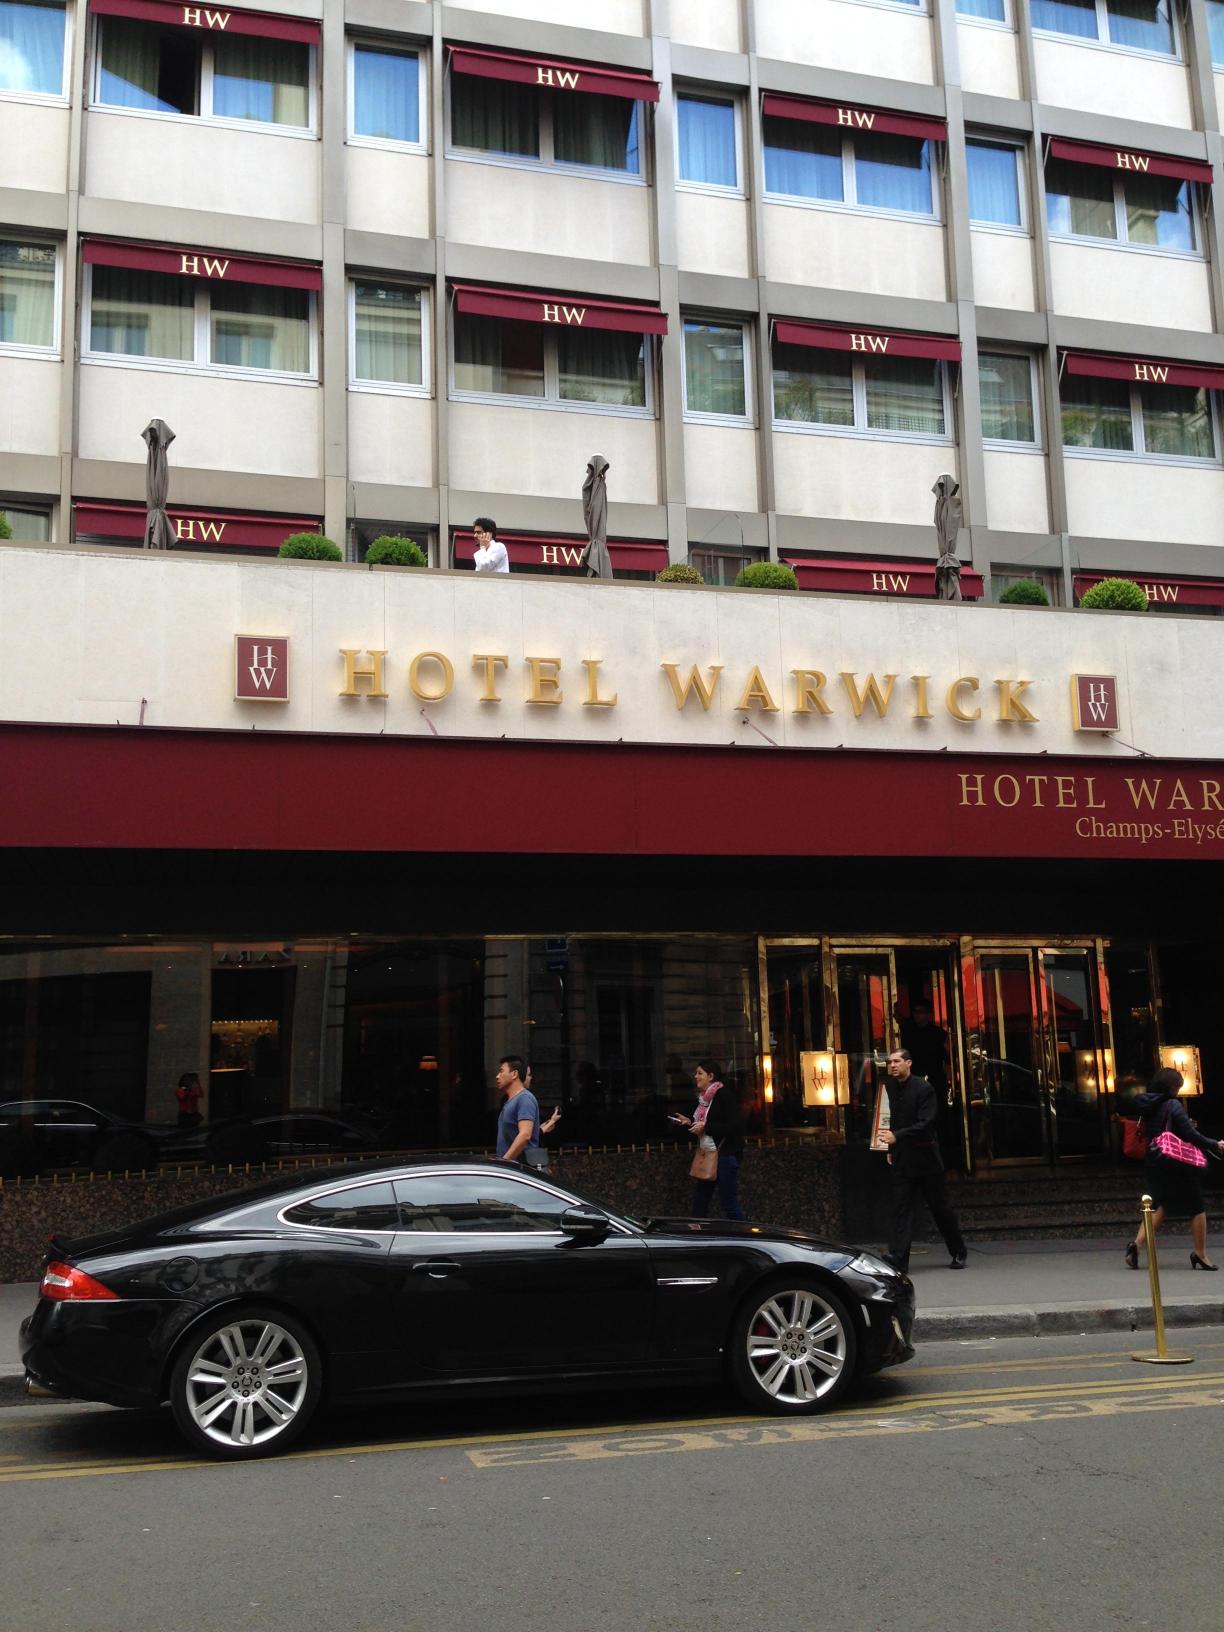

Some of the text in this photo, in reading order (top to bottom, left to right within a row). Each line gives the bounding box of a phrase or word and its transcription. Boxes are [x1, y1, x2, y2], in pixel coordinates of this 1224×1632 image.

[182, 7, 231, 30] HW
[536, 67, 579, 89] HW
[837, 106, 876, 130] HW
[1116, 153, 1151, 173] HW
[180, 254, 230, 279] HW
[542, 303, 586, 325] HW
[850, 333, 890, 354] HW
[1134, 363, 1169, 383] HW
[174, 518, 227, 542] HW
[540, 545, 584, 566] HW
[871, 576, 910, 593] HW
[1144, 584, 1179, 603] HW
[339, 648, 1040, 724] HOTEL WARWICK
[958, 773, 1224, 811] HOTEL WAR
